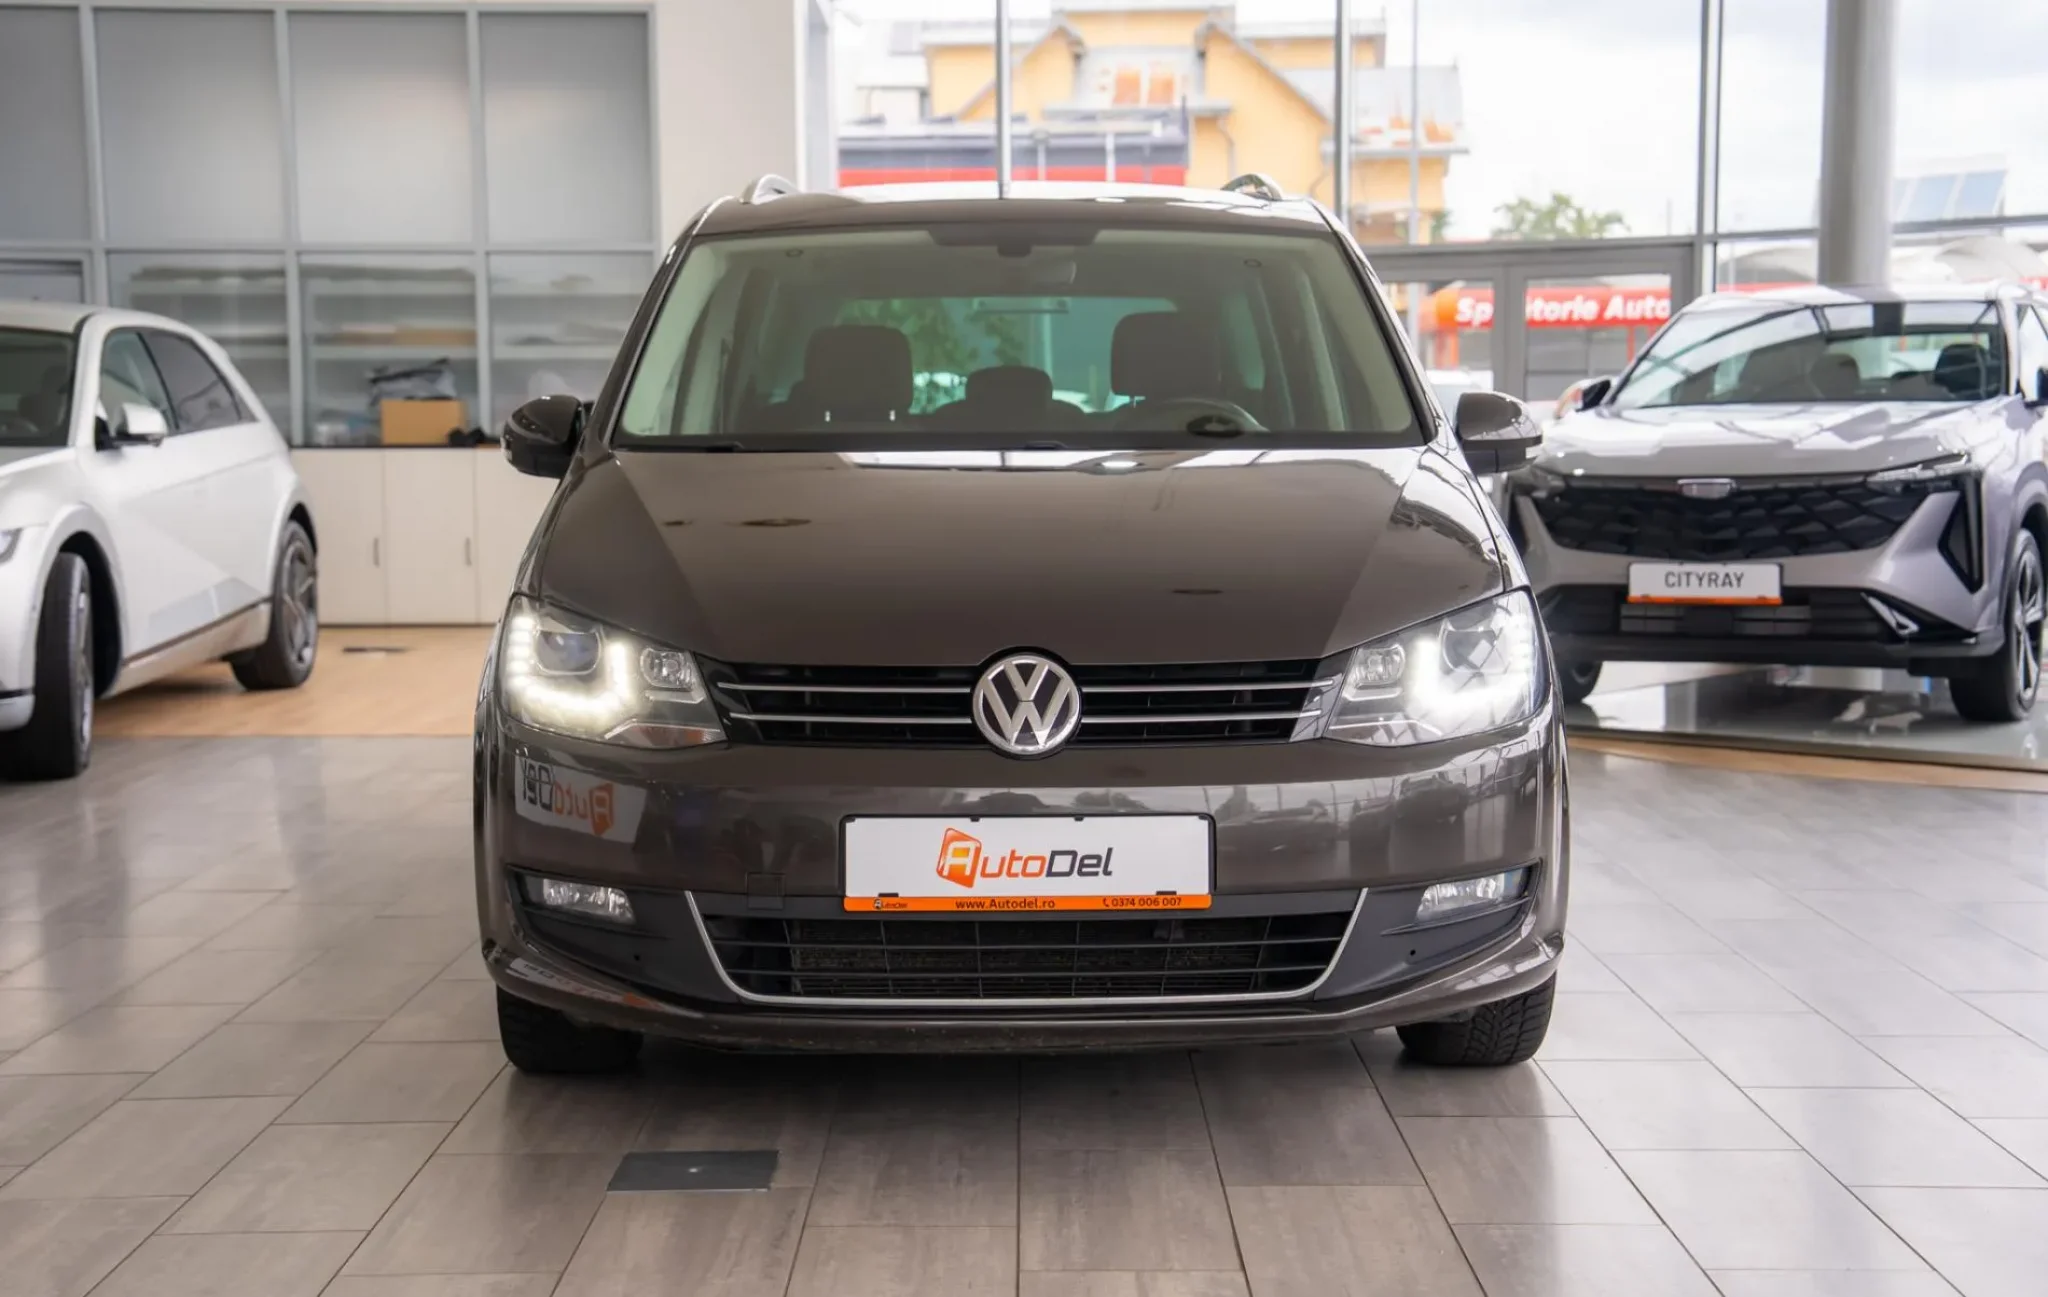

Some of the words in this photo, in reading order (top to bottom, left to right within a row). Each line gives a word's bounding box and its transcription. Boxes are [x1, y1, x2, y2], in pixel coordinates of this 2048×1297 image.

[1455, 295, 1599, 326] Sptorie
[1664, 571, 1744, 589] CITYRAY
[938, 831, 1114, 884] AutoDel
[955, 898, 1056, 910] www.Autodel.ro
[1111, 897, 1136, 907] 0374
[1138, 897, 1160, 907] 006
[1162, 897, 1182, 907] 007
